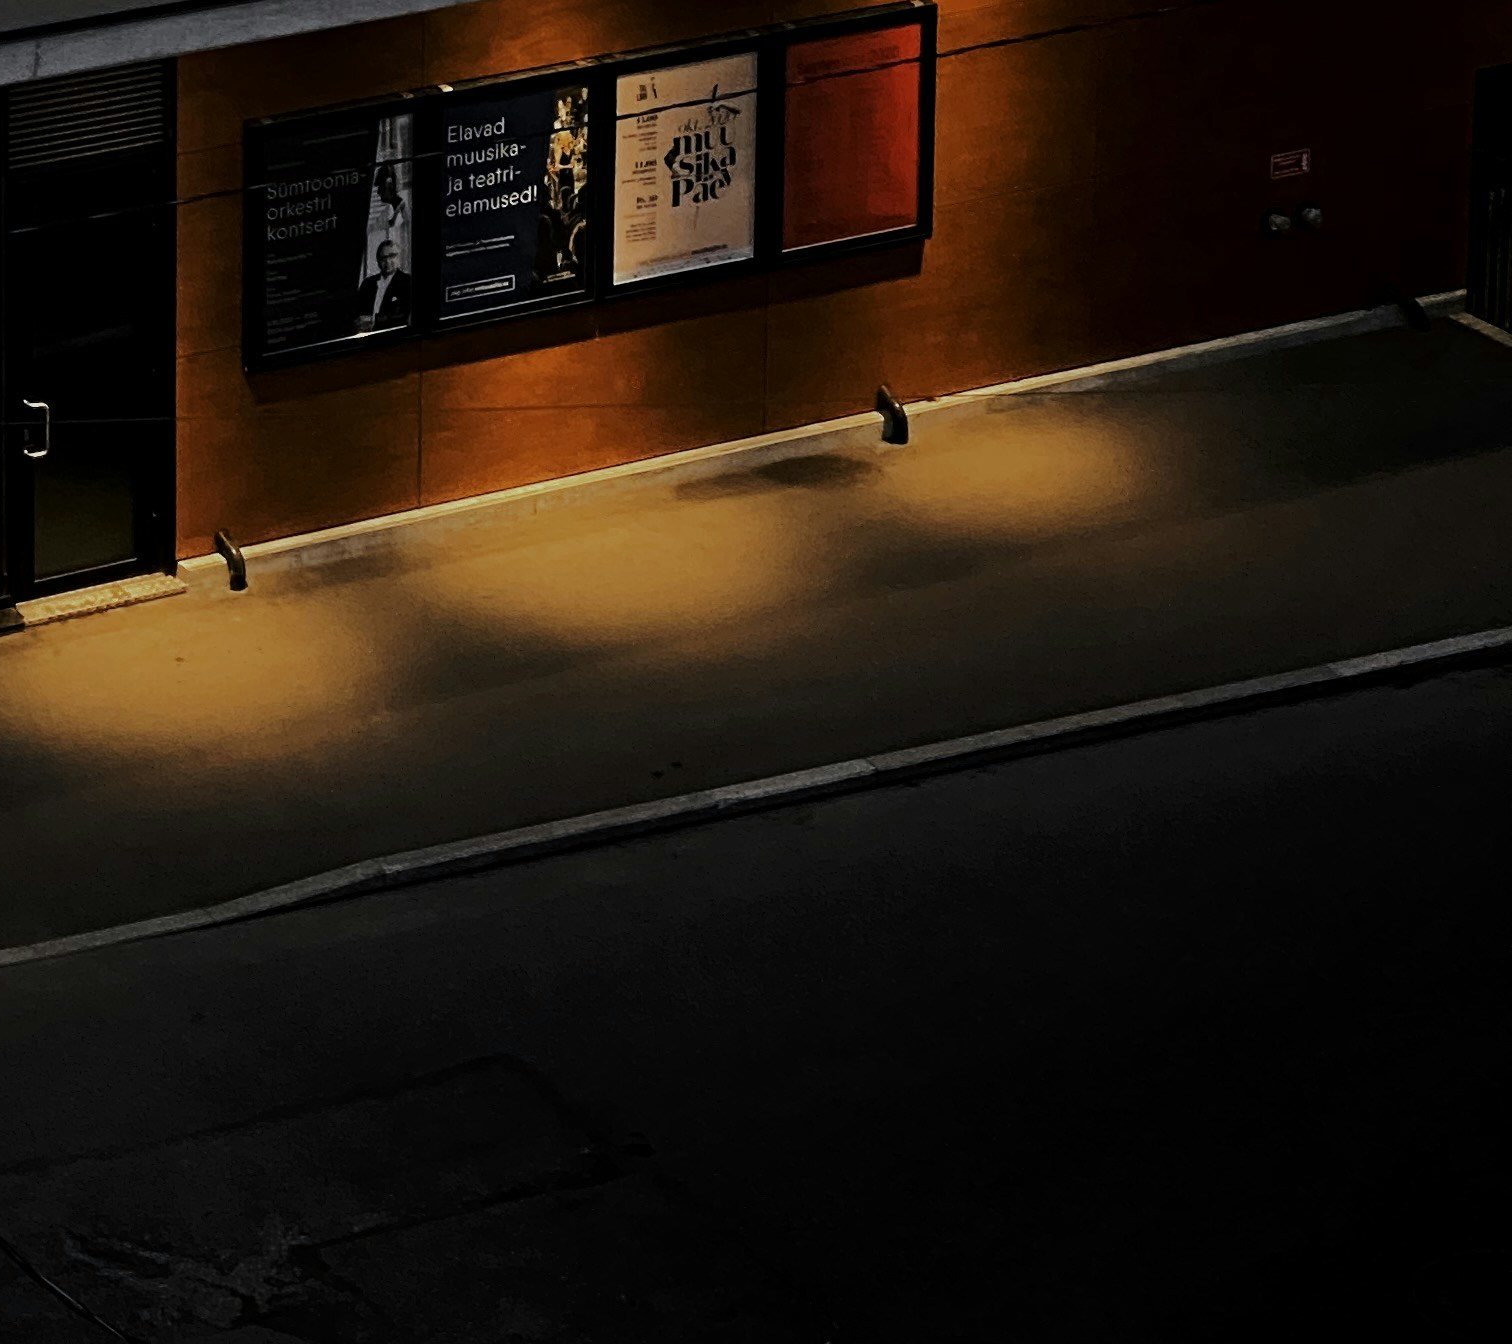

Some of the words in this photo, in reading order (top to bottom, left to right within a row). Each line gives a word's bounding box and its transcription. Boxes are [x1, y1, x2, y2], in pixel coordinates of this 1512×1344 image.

[448, 117, 506, 143] Elavad
[446, 142, 527, 168] muusika-
[446, 174, 463, 196] ja
[469, 165, 522, 189] teatri-
[266, 194, 332, 221] orkestri
[445, 185, 538, 218] elamused!
[266, 214, 339, 241] kontsert
